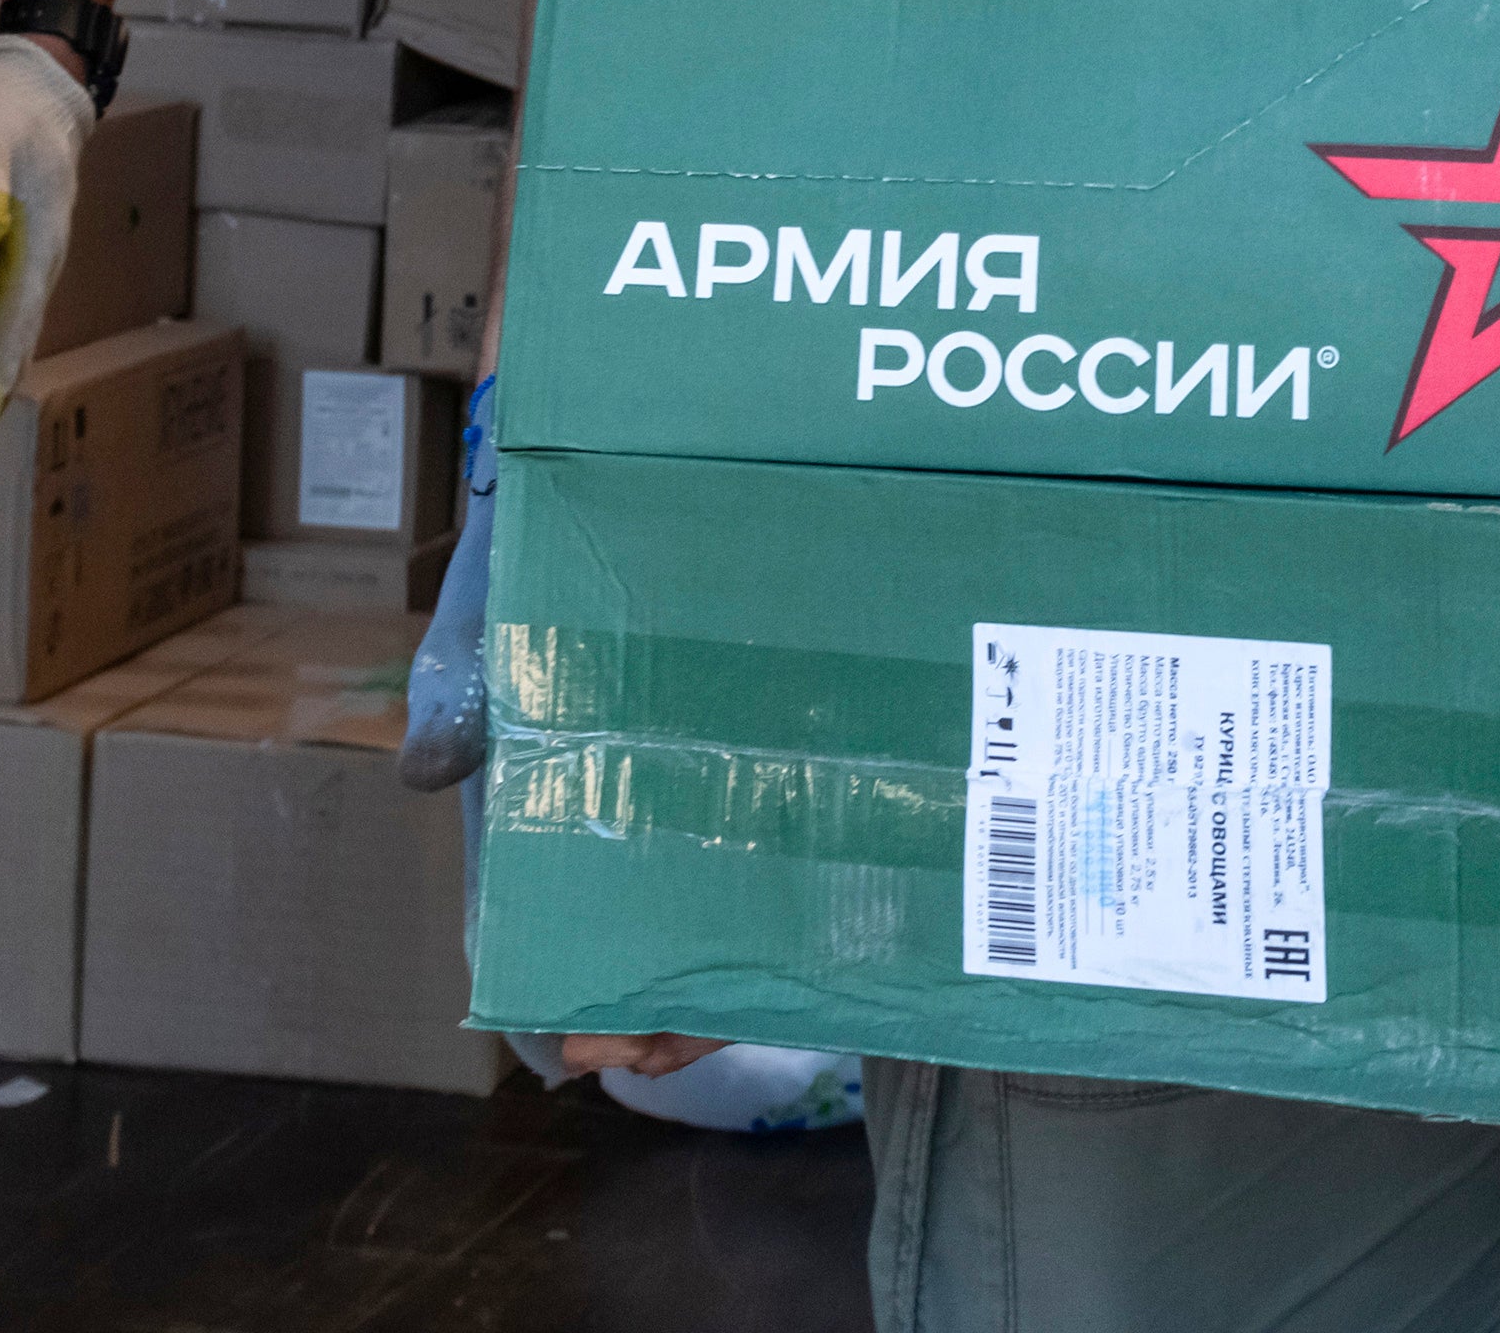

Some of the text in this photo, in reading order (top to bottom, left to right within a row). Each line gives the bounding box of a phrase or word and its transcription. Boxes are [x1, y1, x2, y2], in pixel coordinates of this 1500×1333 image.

[602, 219, 1041, 315] АРМИЯ
[1139, 655, 1150, 696] Масса
[1154, 656, 1165, 697] Масса
[1169, 657, 1180, 699] Масса
[1215, 712, 1235, 787] КУРИЦ
[1209, 811, 1227, 925] ОВОЩАМИ
